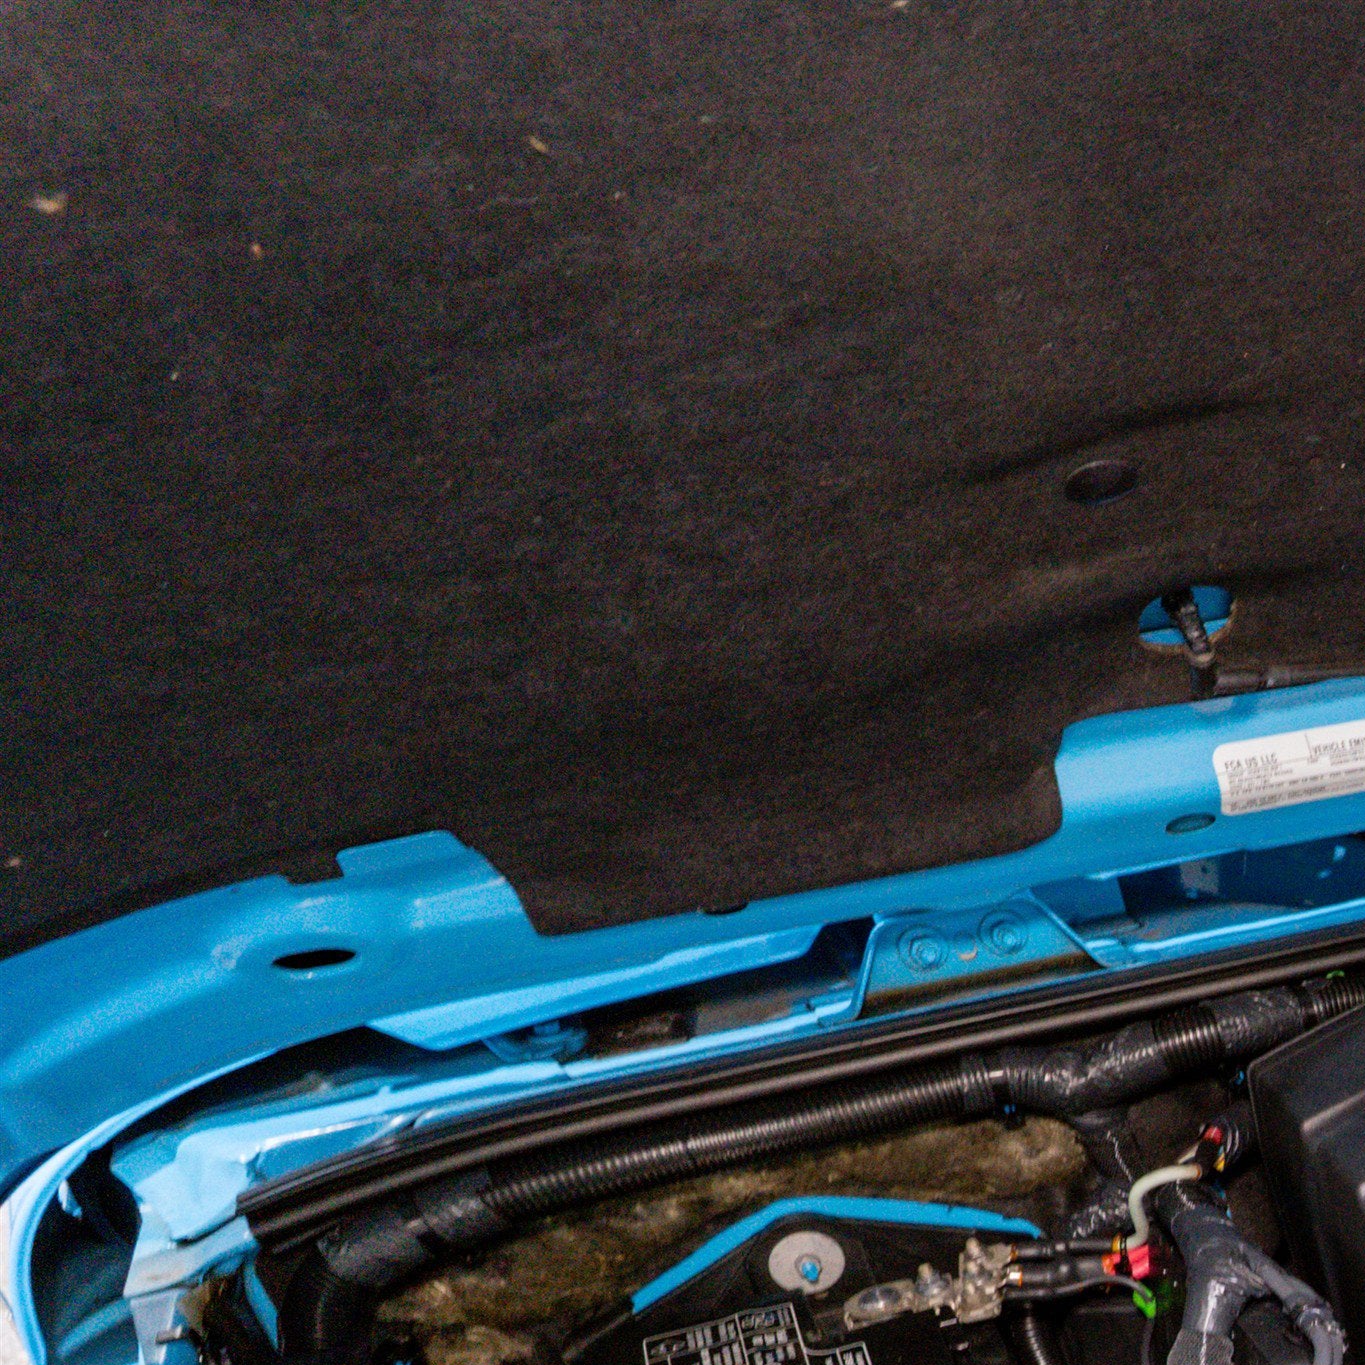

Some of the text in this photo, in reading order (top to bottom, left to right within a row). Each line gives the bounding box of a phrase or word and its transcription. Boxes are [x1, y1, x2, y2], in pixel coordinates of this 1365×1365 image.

[1225, 752, 1278, 770] FCA US LLC
